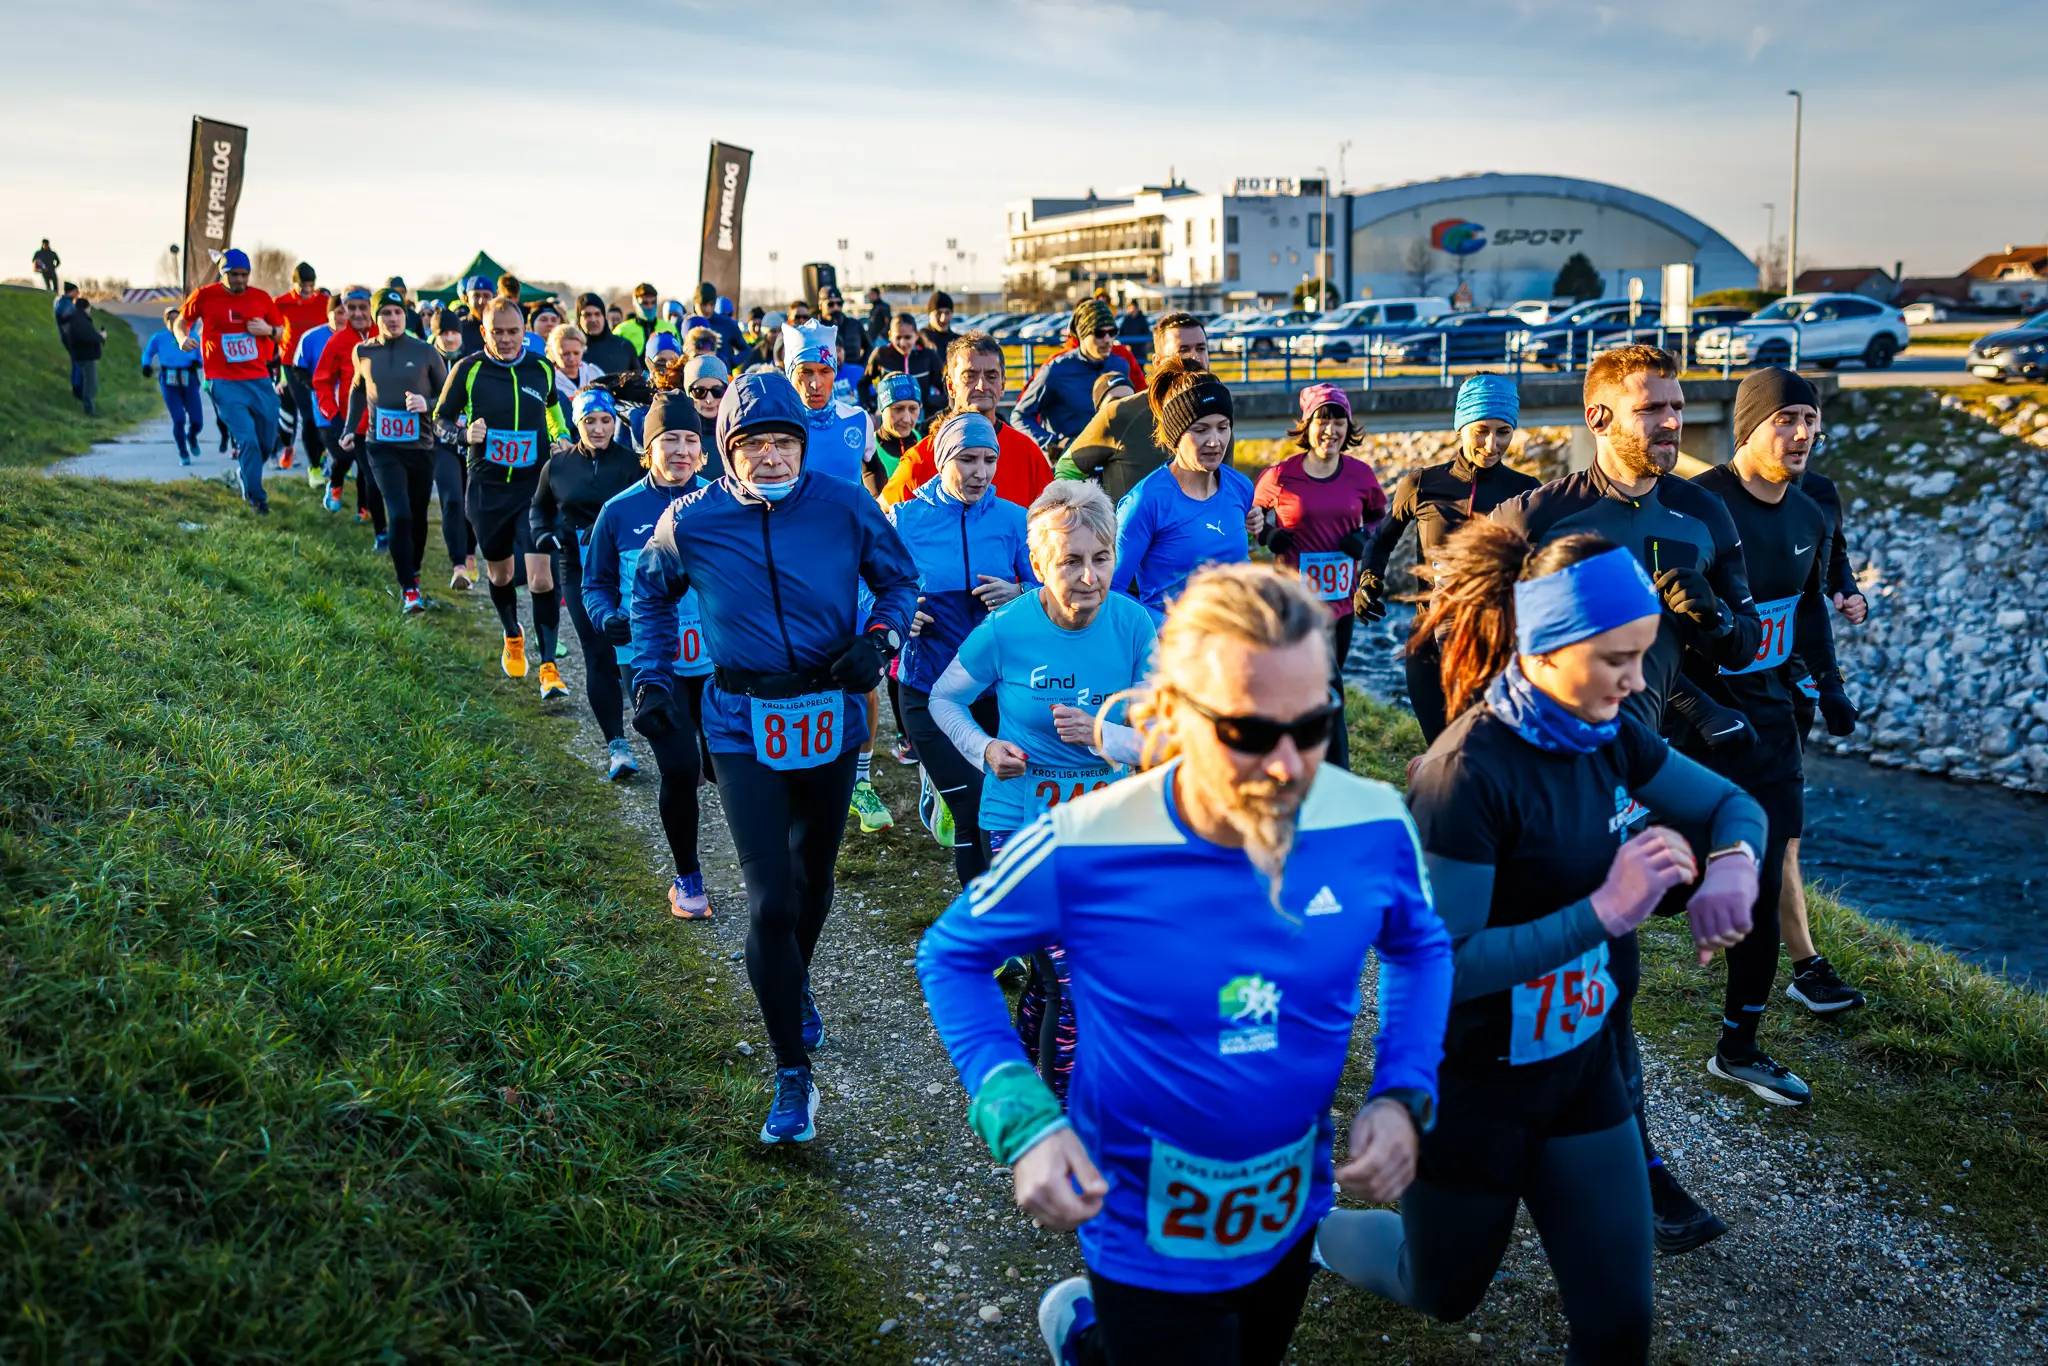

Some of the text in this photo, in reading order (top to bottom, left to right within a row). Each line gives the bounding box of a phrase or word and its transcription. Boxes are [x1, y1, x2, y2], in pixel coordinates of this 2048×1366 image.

[205, 140, 232, 240] BK PRELOG
[1493, 229, 1584, 246] SPORT
[226, 338, 255, 358] 863
[381, 417, 415, 438] 894
[491, 439, 532, 464] 307
[1307, 562, 1349, 593] 893
[1030, 664, 1075, 689] Fund
[762, 696, 834, 711] KROS LIGA PRELOG
[764, 710, 834, 760] 818
[1032, 767, 1109, 779] KROS LIGA PRELOG
[1162, 1165, 1302, 1246] 263
